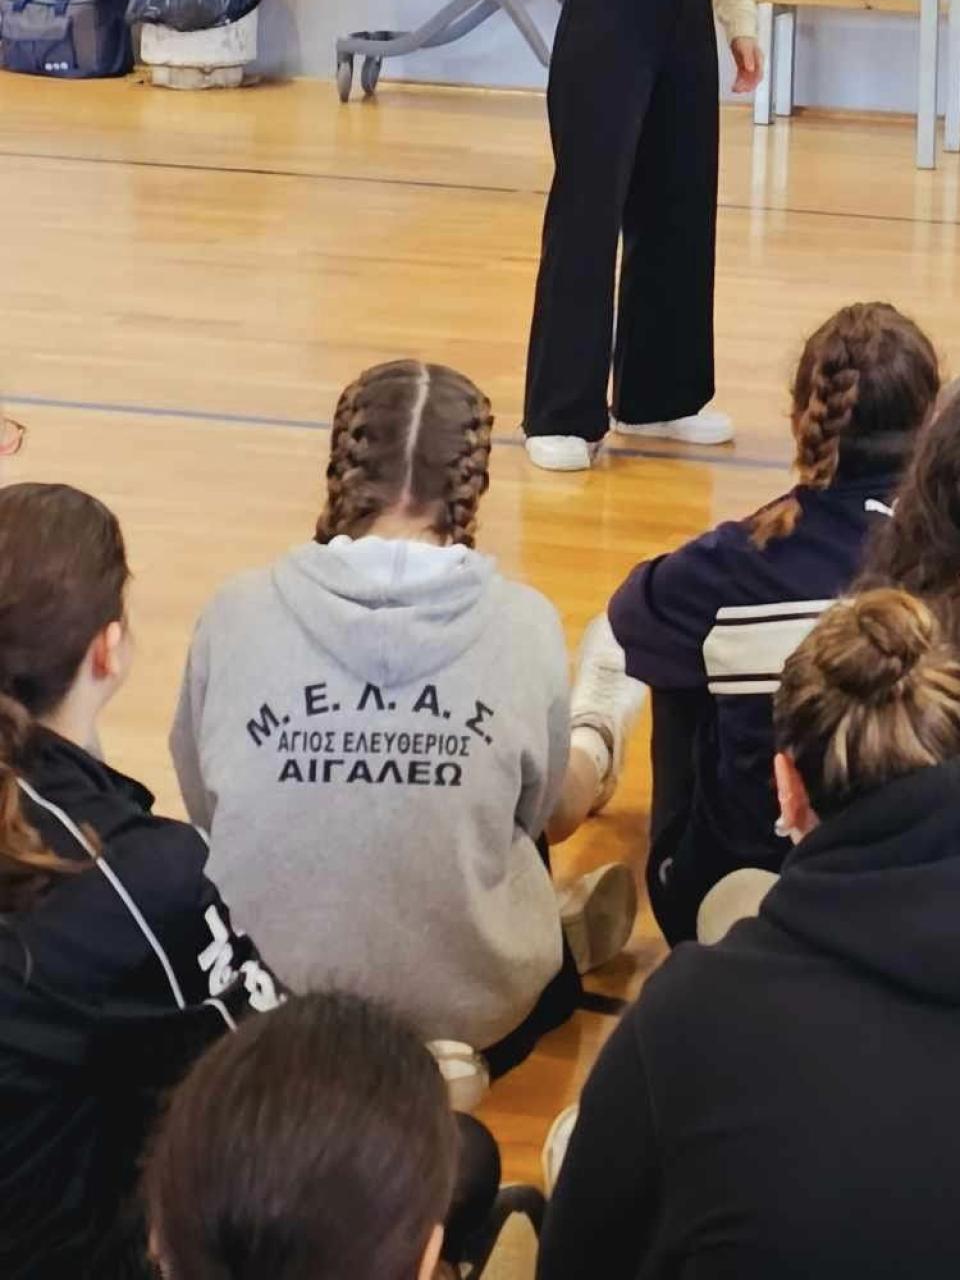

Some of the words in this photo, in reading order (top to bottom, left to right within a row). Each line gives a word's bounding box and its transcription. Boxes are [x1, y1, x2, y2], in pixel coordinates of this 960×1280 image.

[277, 730, 335, 753] ΑΓΙΟΣ
[342, 731, 471, 757] ΕΛΕΥΘΕΡΙΟΣ
[277, 758, 463, 787] ΑΙΓΑΛΕΩ
